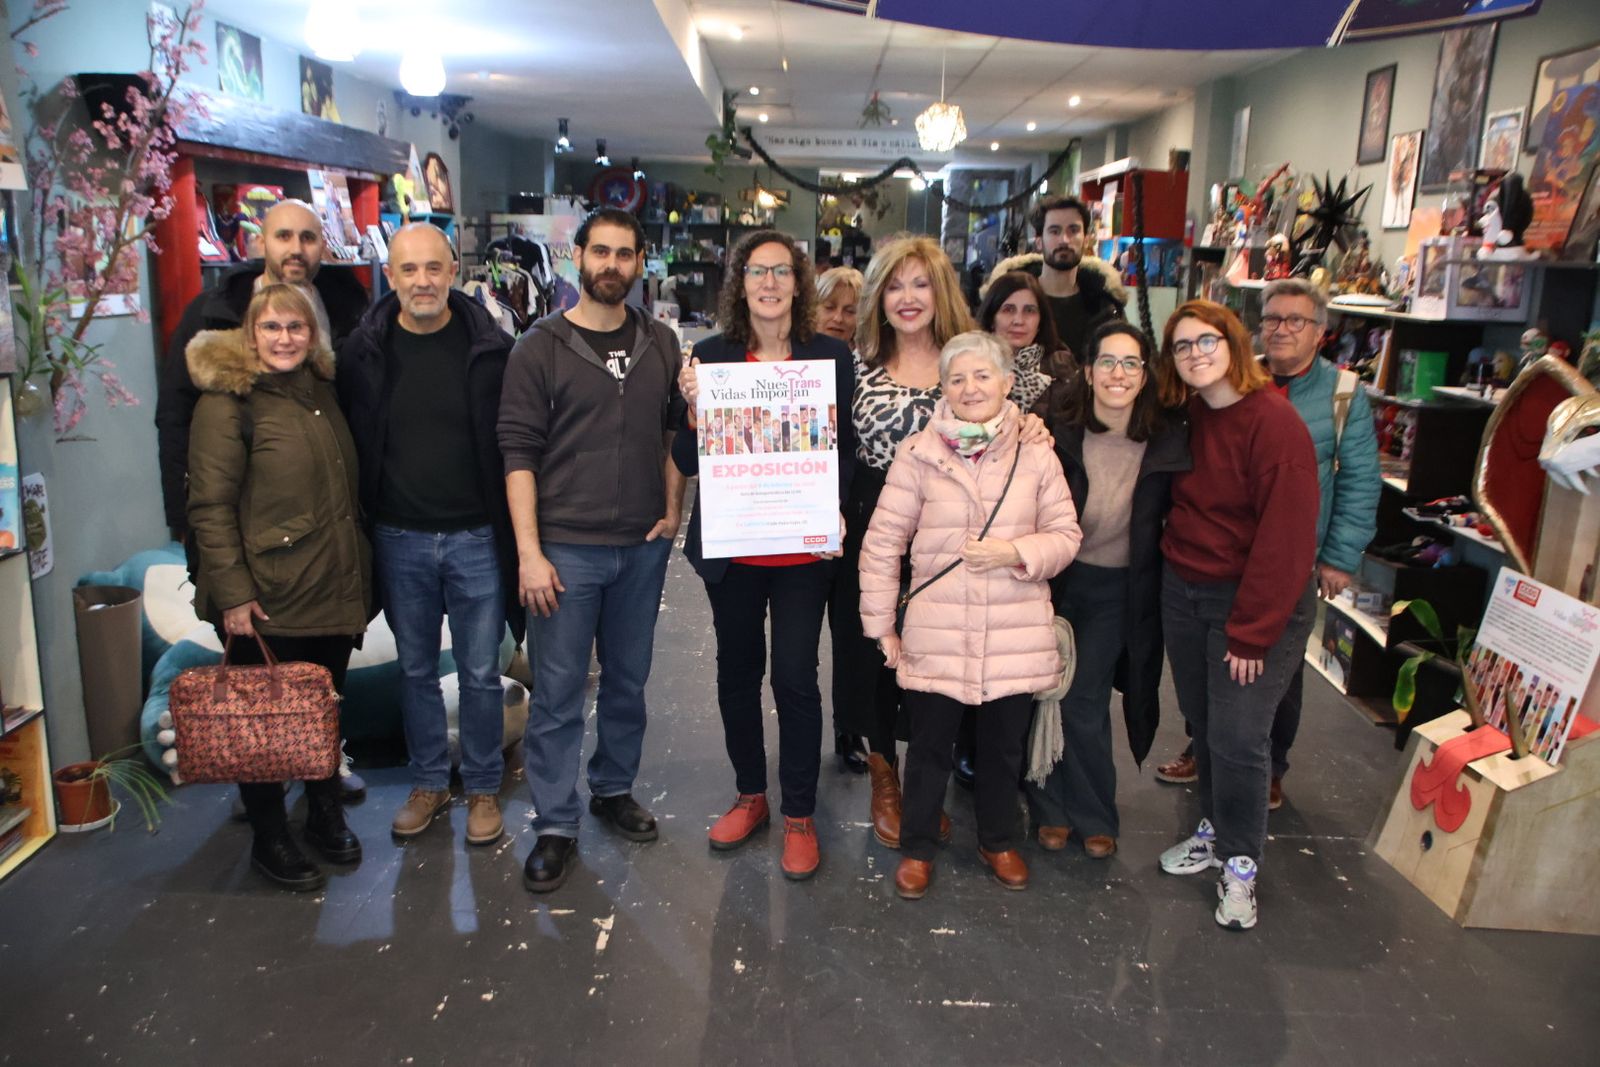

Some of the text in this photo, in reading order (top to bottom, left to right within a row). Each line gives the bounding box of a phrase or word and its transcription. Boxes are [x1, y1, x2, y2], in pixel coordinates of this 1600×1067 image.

[608, 350, 627, 358] THE
[710, 388, 746, 401] Vidas
[712, 458, 828, 478] EXPOSICIÓN
